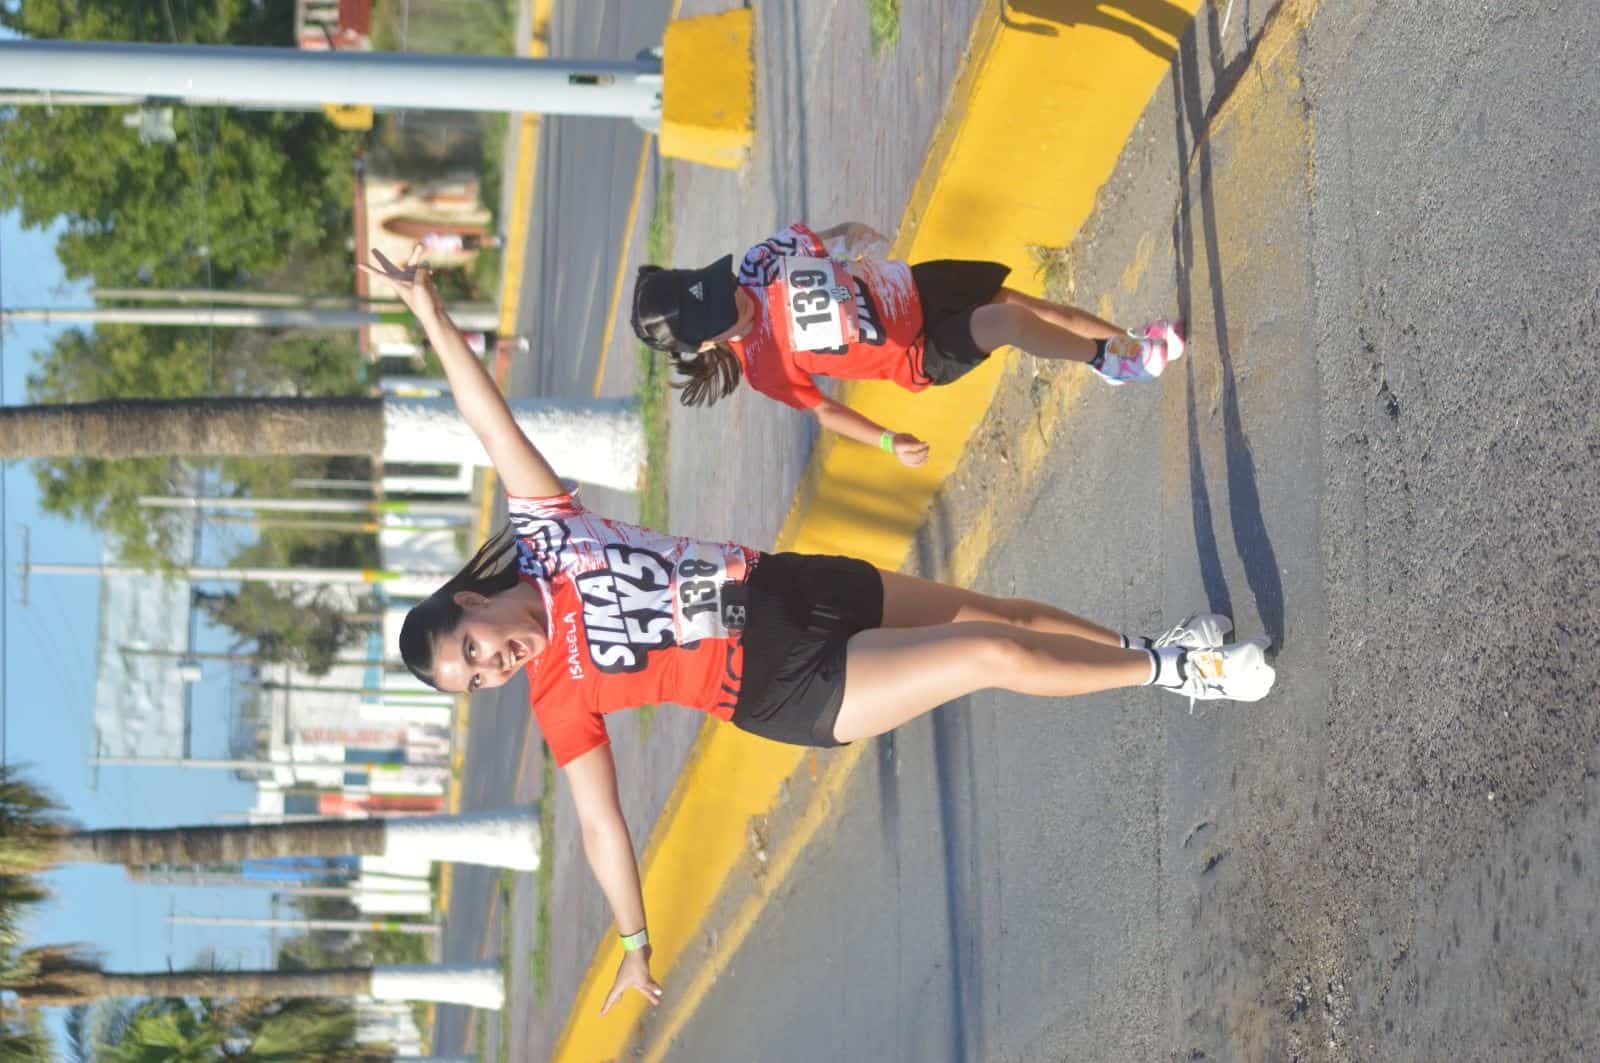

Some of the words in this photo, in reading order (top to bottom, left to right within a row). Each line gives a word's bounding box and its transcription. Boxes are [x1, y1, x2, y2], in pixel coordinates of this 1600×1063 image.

[789, 269, 833, 331] 139
[576, 575, 636, 667] SIKA
[678, 558, 719, 622] 138
[563, 611, 584, 680] ISABELA
